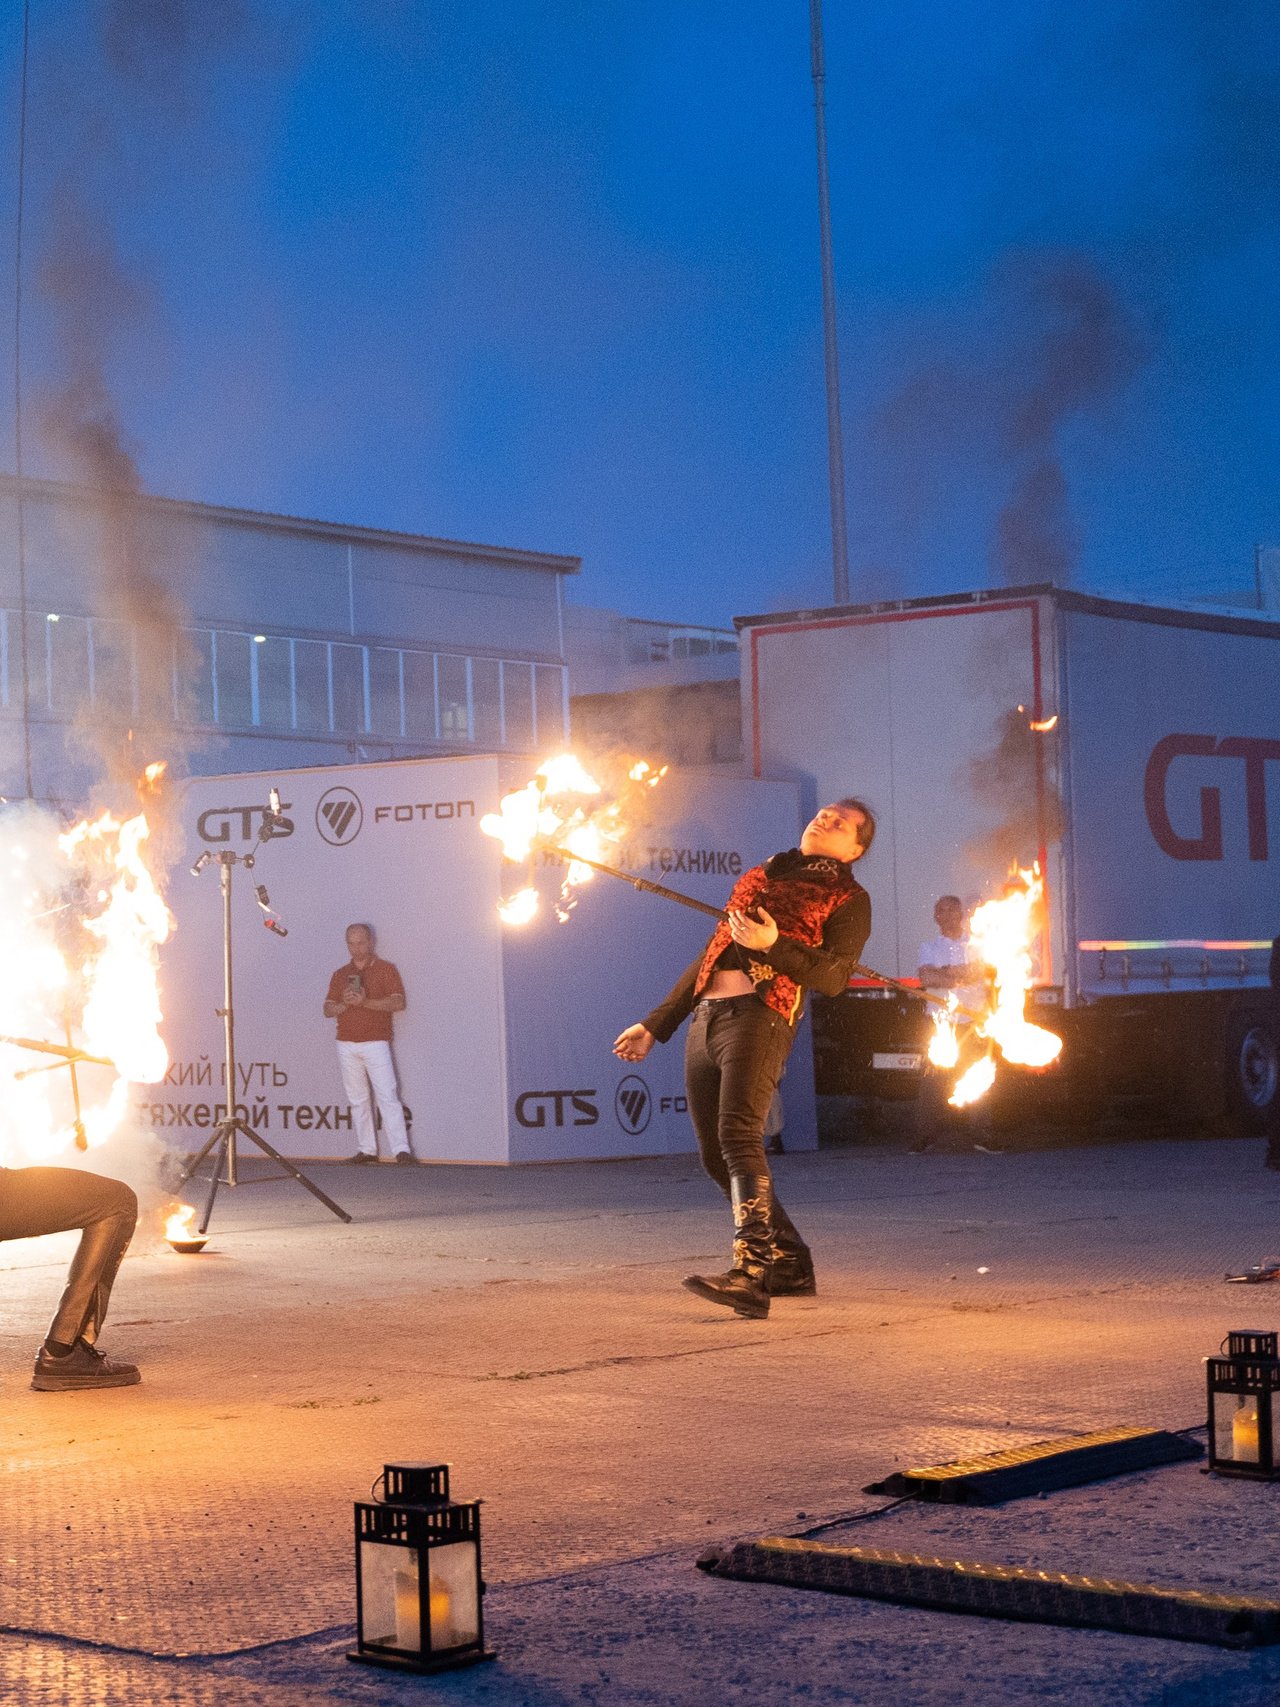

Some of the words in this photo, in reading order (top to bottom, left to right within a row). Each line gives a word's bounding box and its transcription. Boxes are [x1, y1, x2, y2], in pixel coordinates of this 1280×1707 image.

[1144, 733, 1280, 861] GT
[197, 803, 294, 842] GTS
[374, 800, 475, 823] FOTON
[646, 847, 742, 876] технике
[163, 1055, 211, 1086] кий
[515, 1089, 599, 1128] GTS
